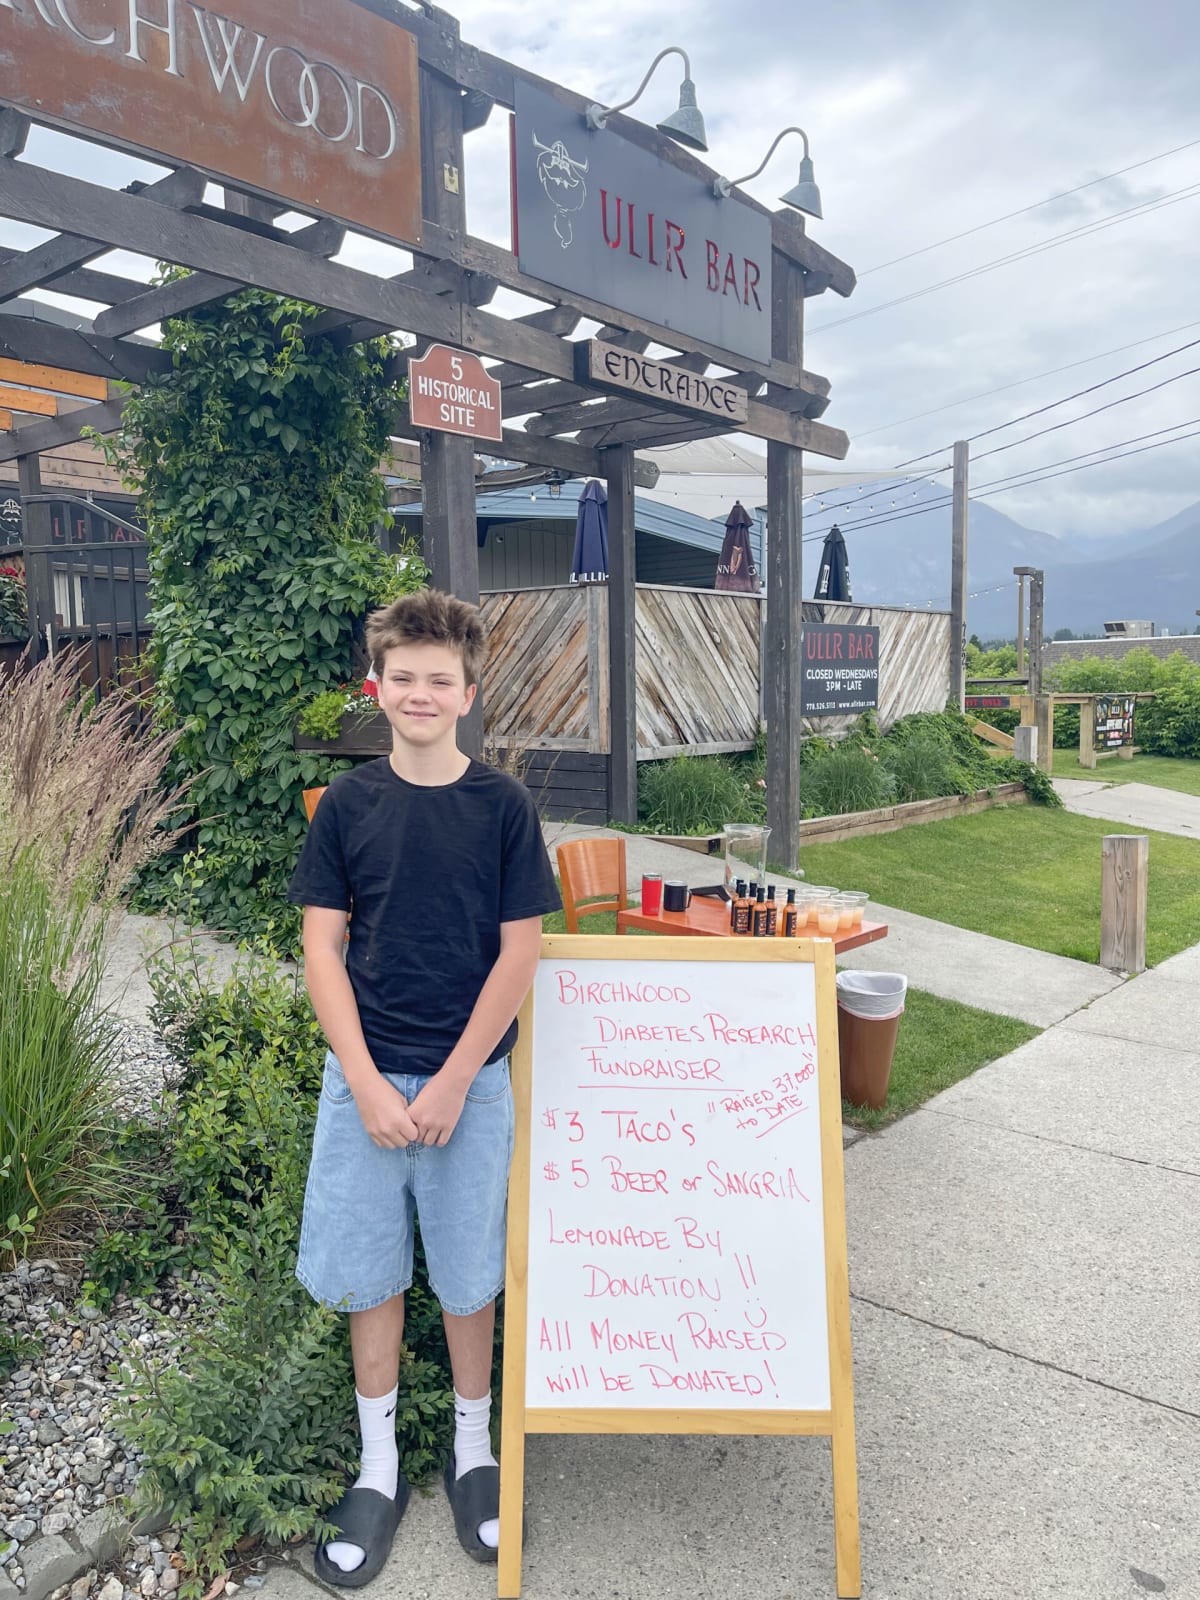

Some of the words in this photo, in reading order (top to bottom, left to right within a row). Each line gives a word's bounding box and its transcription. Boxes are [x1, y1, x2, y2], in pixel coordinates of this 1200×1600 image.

[599, 188, 688, 279] ULLR
[705, 239, 762, 312] BAR
[450, 356, 464, 381] 5
[604, 350, 738, 413] ENTRANCE
[418, 375, 496, 410] HISTORICAL
[440, 403, 476, 428] SITE
[806, 632, 843, 660] ULLR
[847, 633, 874, 660] BAR
[806, 669, 834, 680] CLOSED
[834, 669, 878, 679] WEDNESDAYS
[554, 970, 692, 1005] BIRCHWOOD
[756, 1094, 804, 1121] DATE
[601, 1155, 670, 1195] BEER
[681, 1175, 703, 1192] or
[706, 1159, 811, 1203] SANGRIA
[539, 1316, 572, 1352] All
[677, 1311, 787, 1352] RAISED
[545, 1364, 589, 1393] will
[639, 1359, 780, 1400] DONATED!
